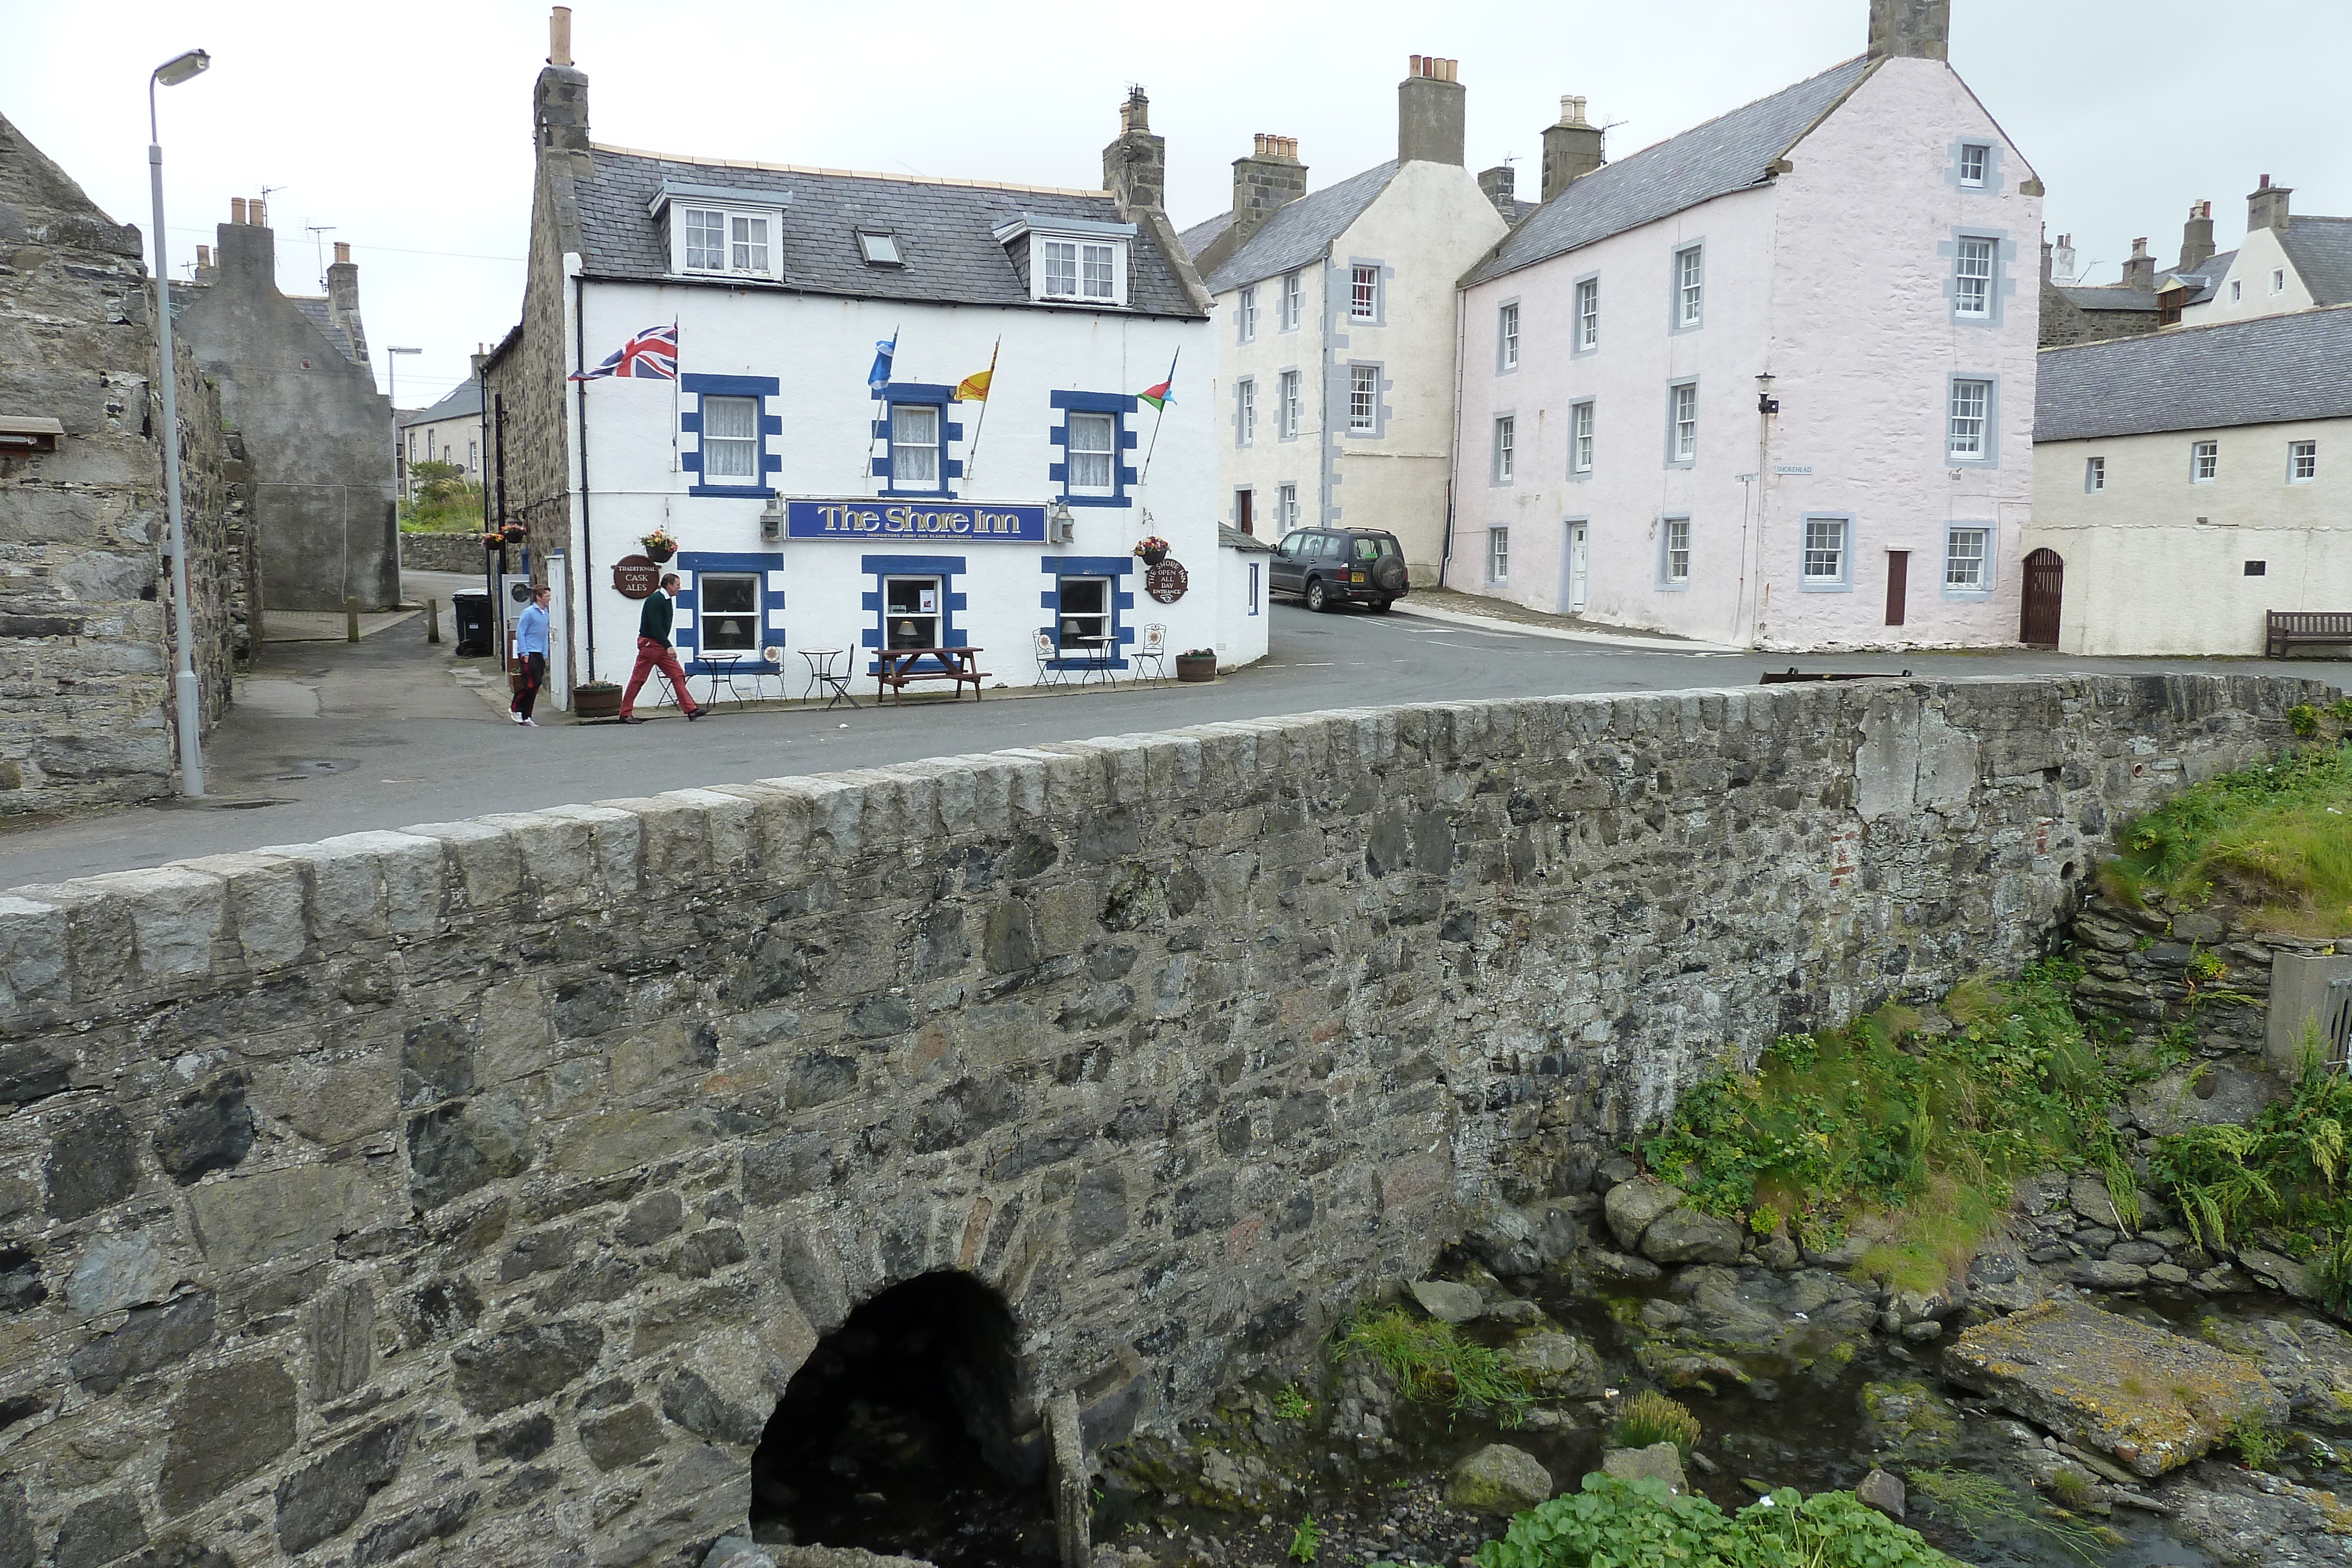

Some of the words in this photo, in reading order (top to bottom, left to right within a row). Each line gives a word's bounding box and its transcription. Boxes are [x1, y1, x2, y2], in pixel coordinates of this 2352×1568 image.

[817, 504, 880, 532] The
[884, 506, 970, 533] Shore
[973, 509, 1021, 533] Inn
[1148, 569, 1157, 586] THE
[1156, 560, 1180, 570] SHORE
[1178, 569, 1187, 583] INN
